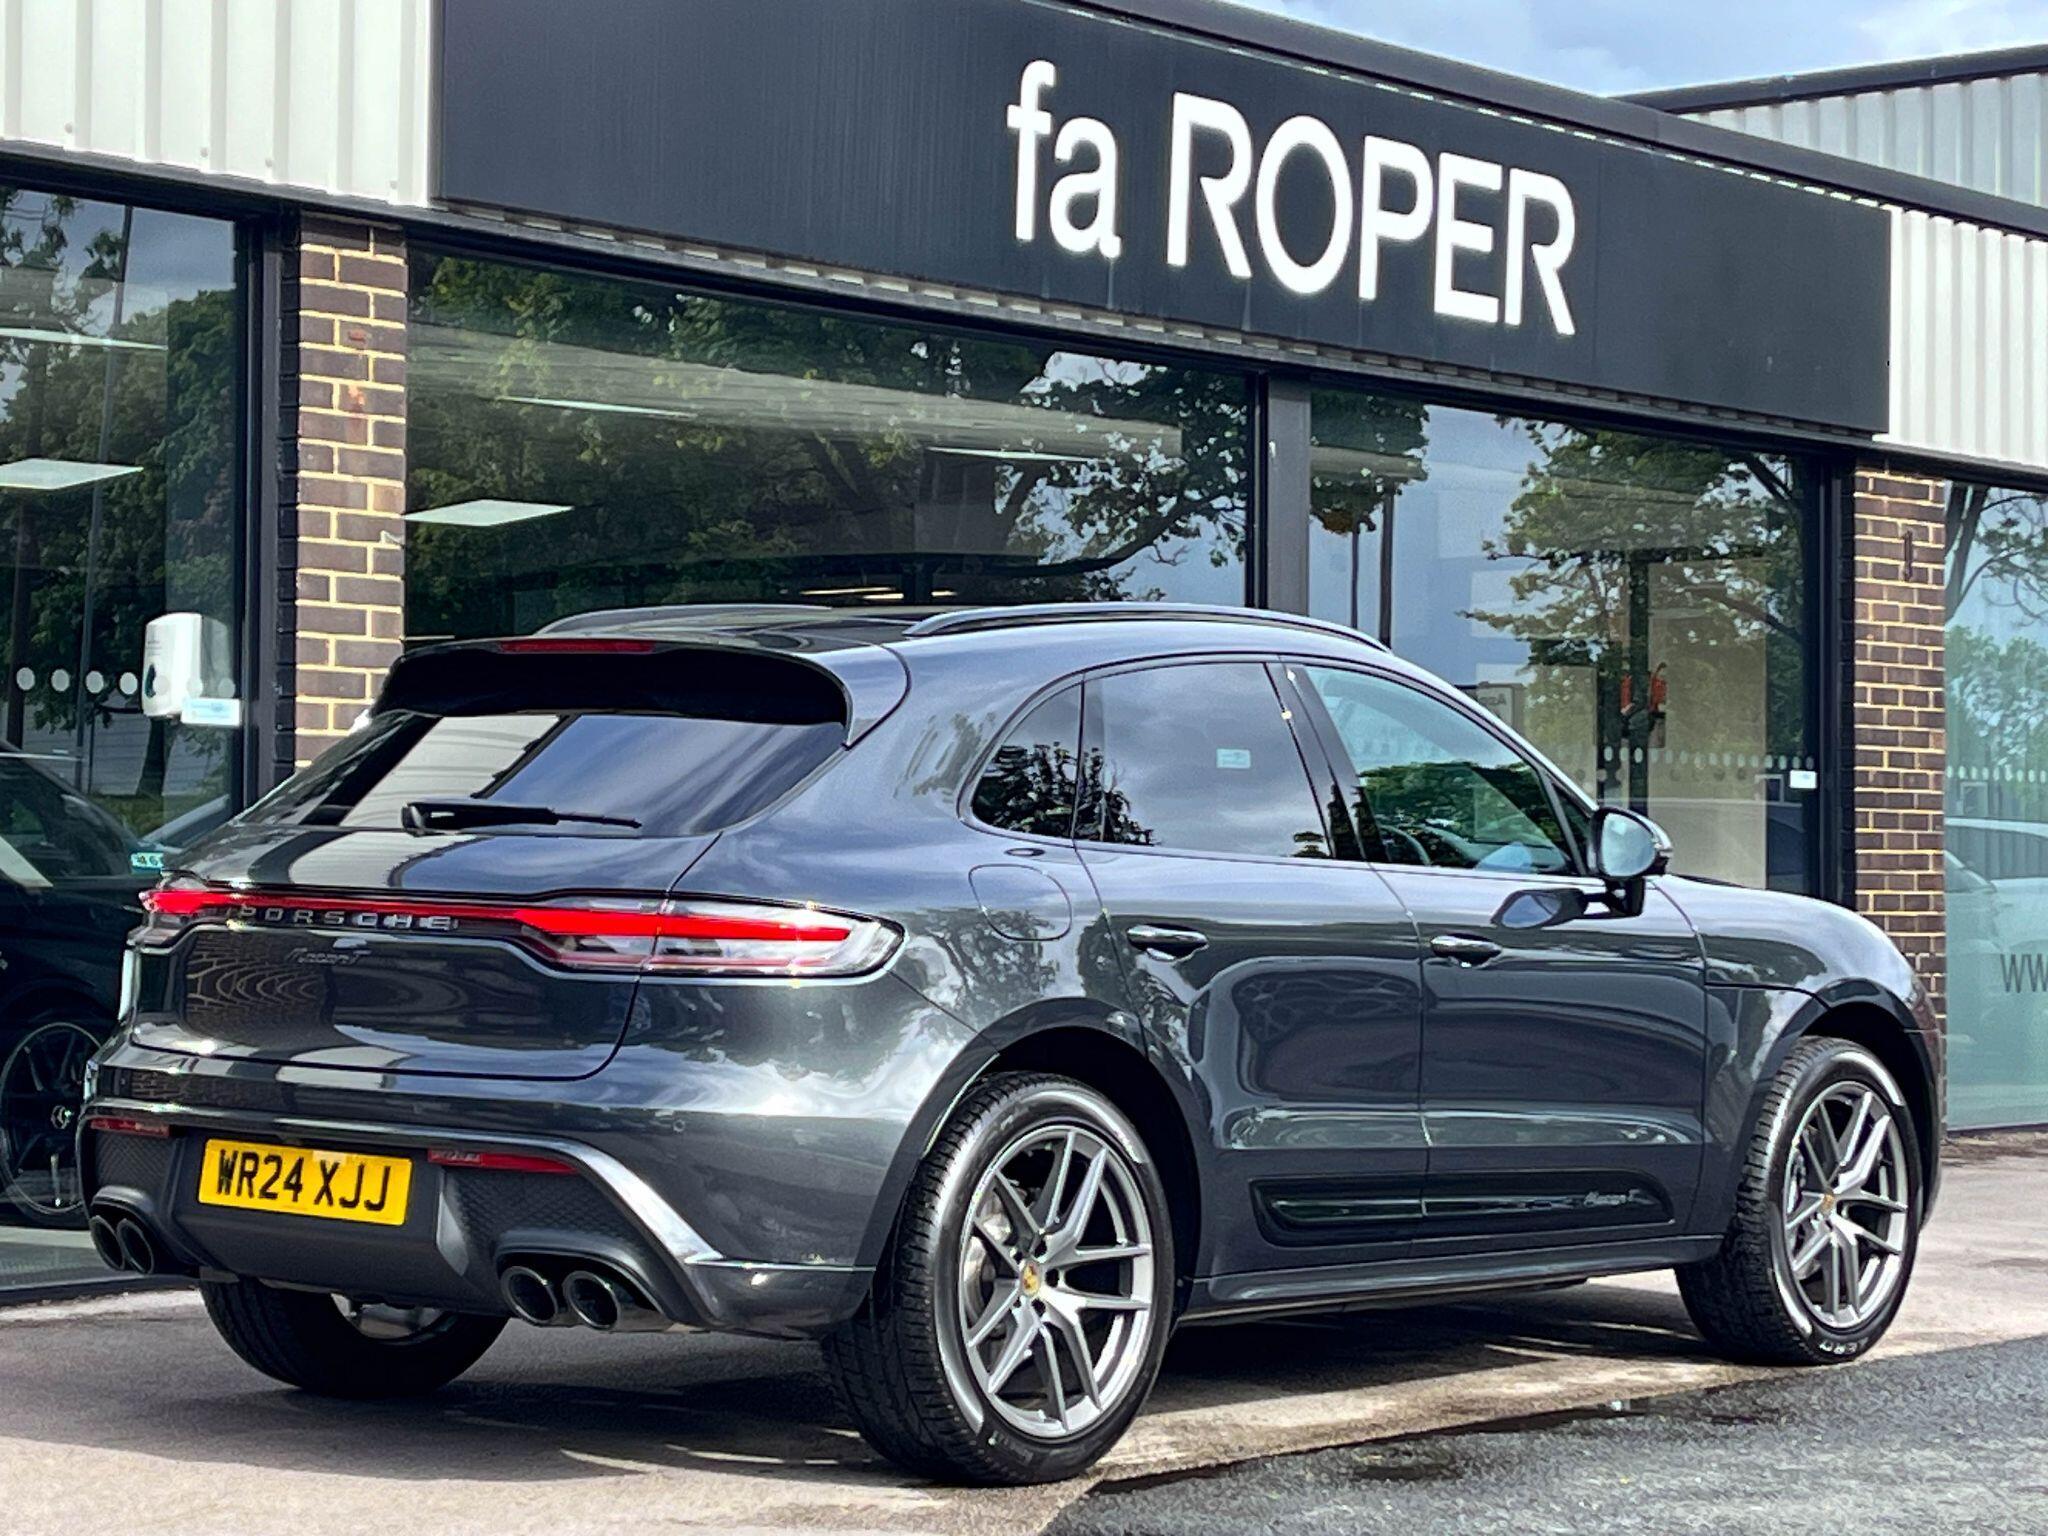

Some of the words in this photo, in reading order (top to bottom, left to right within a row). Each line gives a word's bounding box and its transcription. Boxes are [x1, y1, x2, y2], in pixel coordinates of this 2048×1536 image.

[1007, 60, 1121, 259] fa
[1166, 91, 1576, 336] ROPER
[240, 903, 454, 931] PORSCHE
[217, 1149, 304, 1202] WR24
[314, 1160, 391, 1212] XJJ
